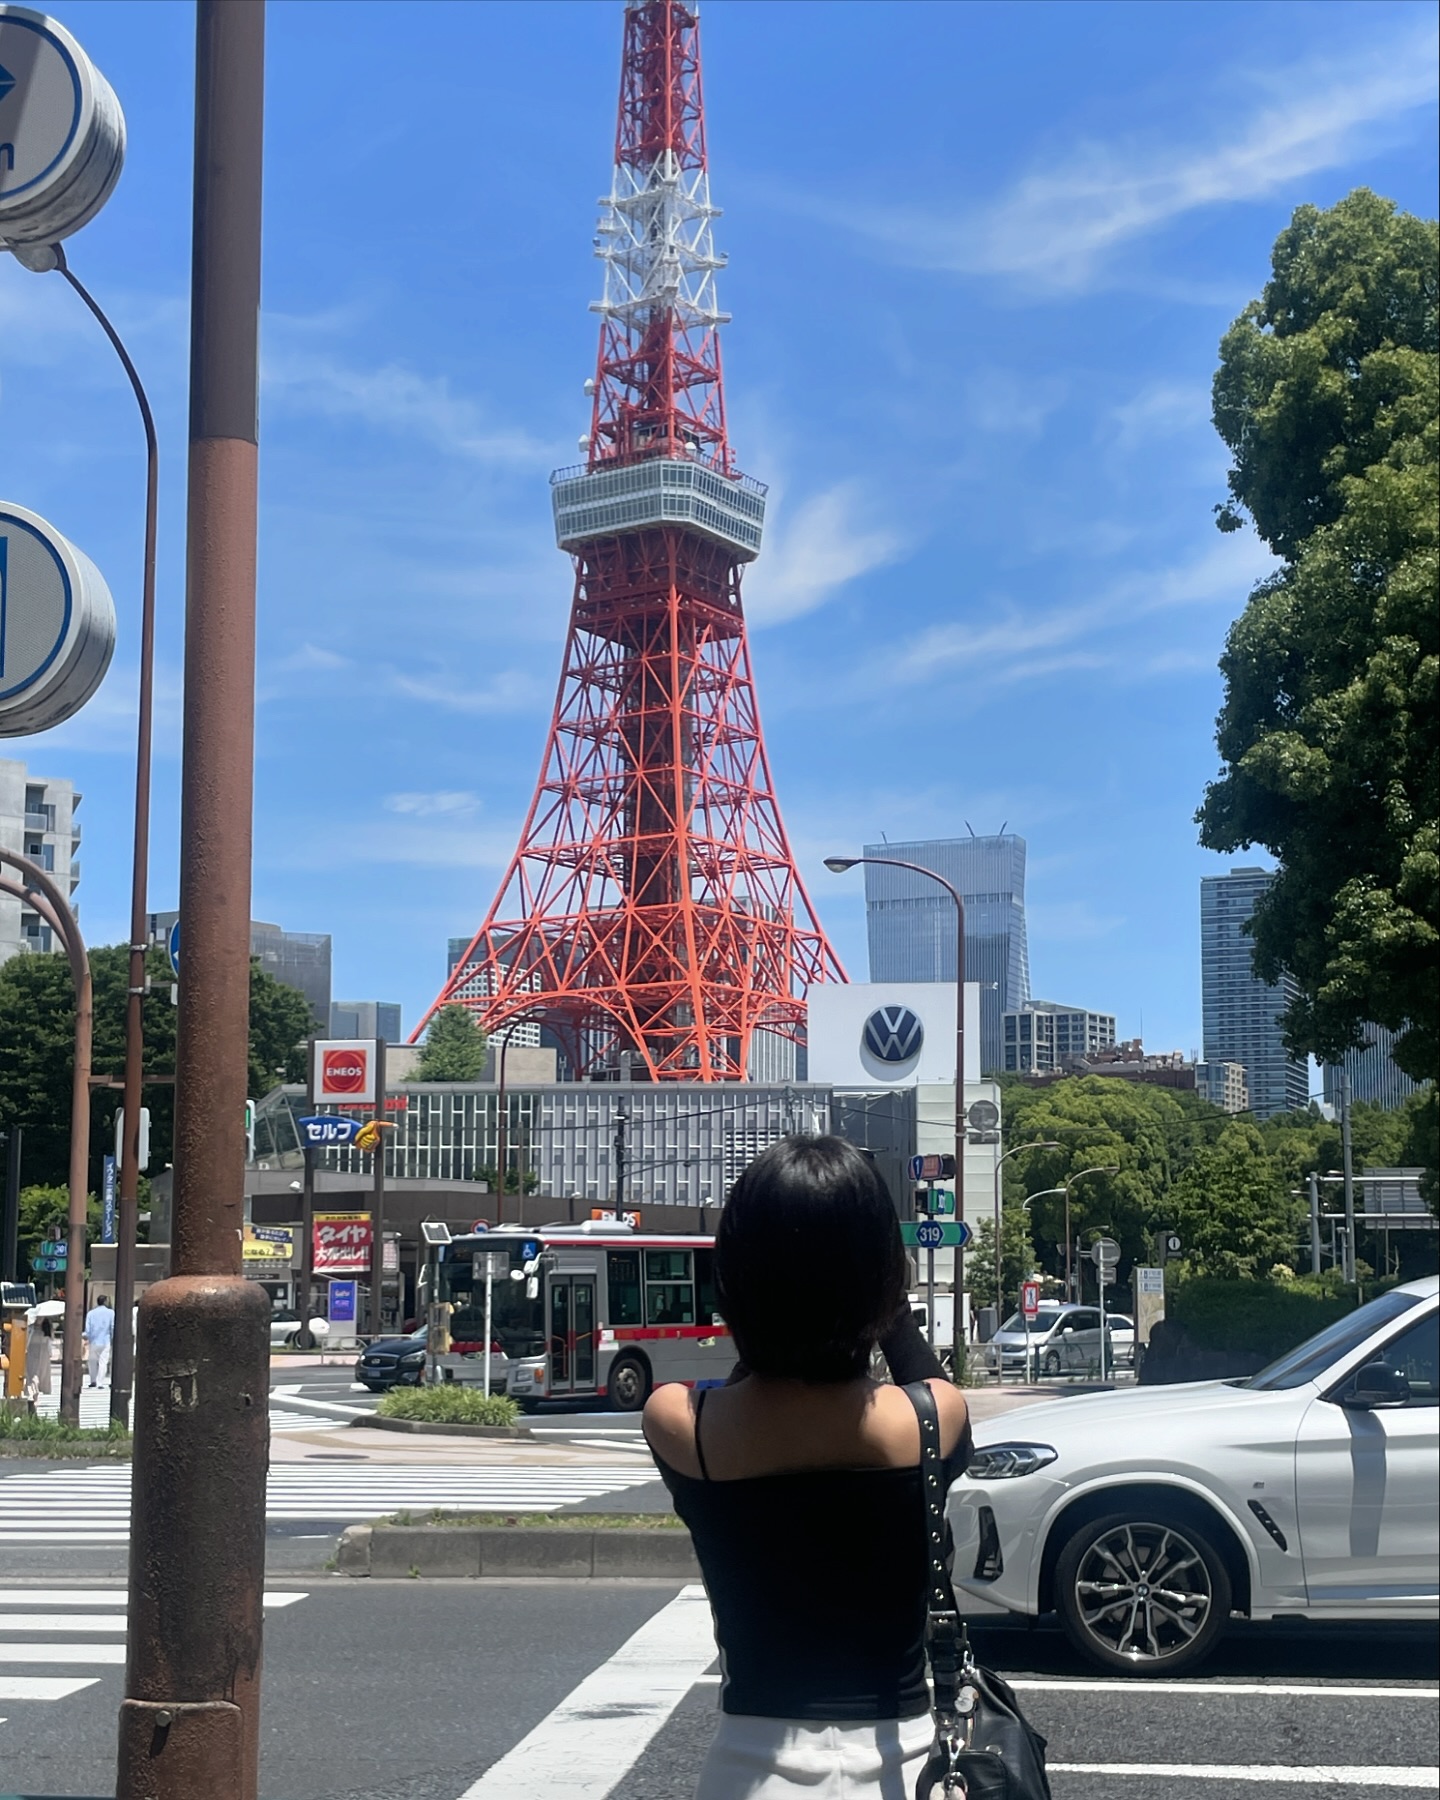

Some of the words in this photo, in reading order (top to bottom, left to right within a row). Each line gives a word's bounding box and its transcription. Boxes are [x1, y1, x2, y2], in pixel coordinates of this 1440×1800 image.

[865, 1006, 920, 1059] VW
[326, 1067, 362, 1076] ENEOS
[306, 1123, 352, 1140] セルフ
[602, 1211, 636, 1227] ENOS
[318, 1225, 367, 1244] タイヤ
[920, 1227, 940, 1242] 319
